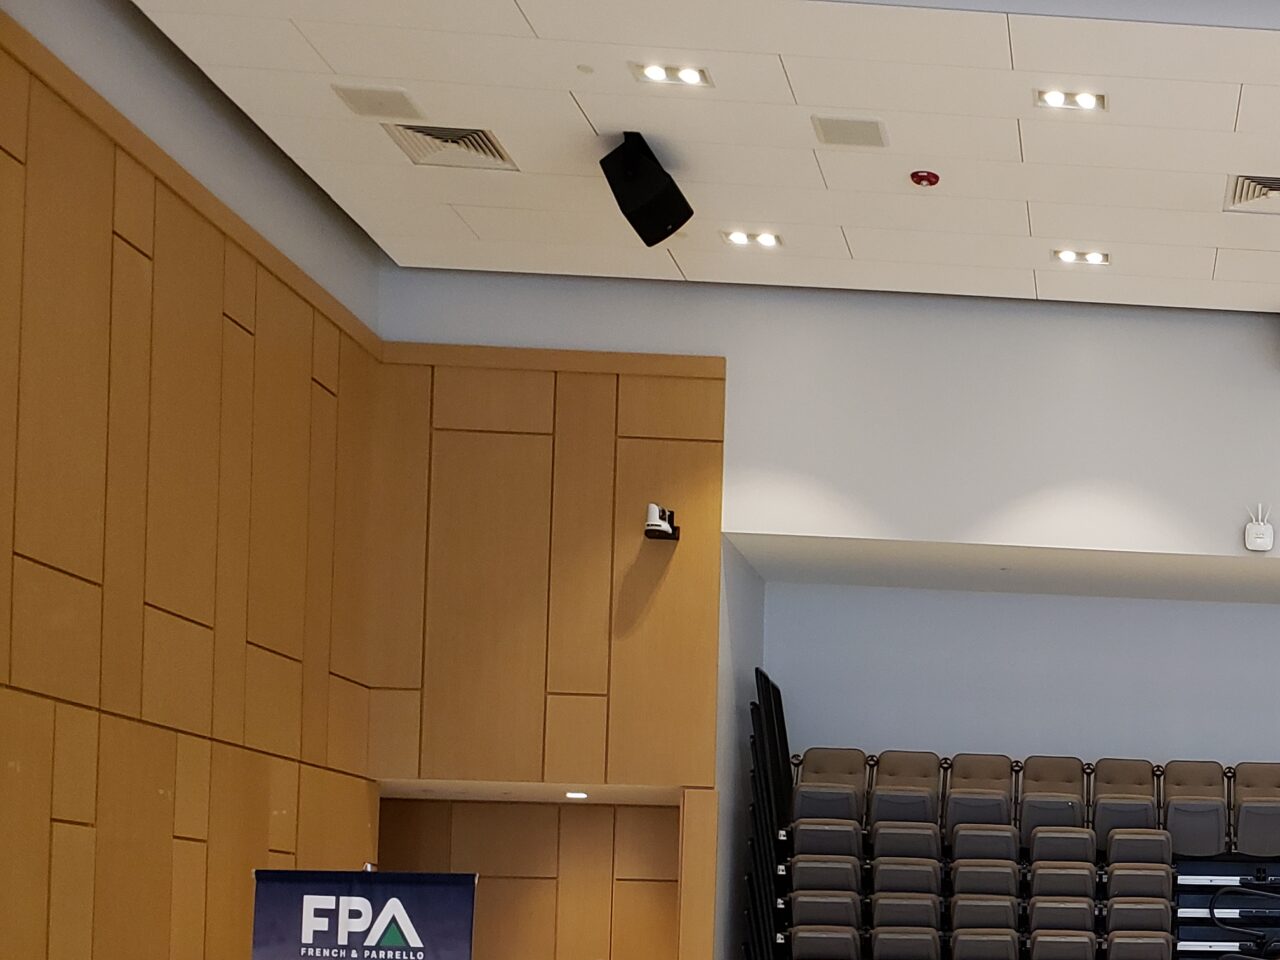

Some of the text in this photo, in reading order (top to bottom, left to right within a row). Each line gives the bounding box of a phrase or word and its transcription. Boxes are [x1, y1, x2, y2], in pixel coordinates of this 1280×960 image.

[301, 894, 424, 947] FPA
[300, 947, 424, 960] FRENCH & PARRELLO
